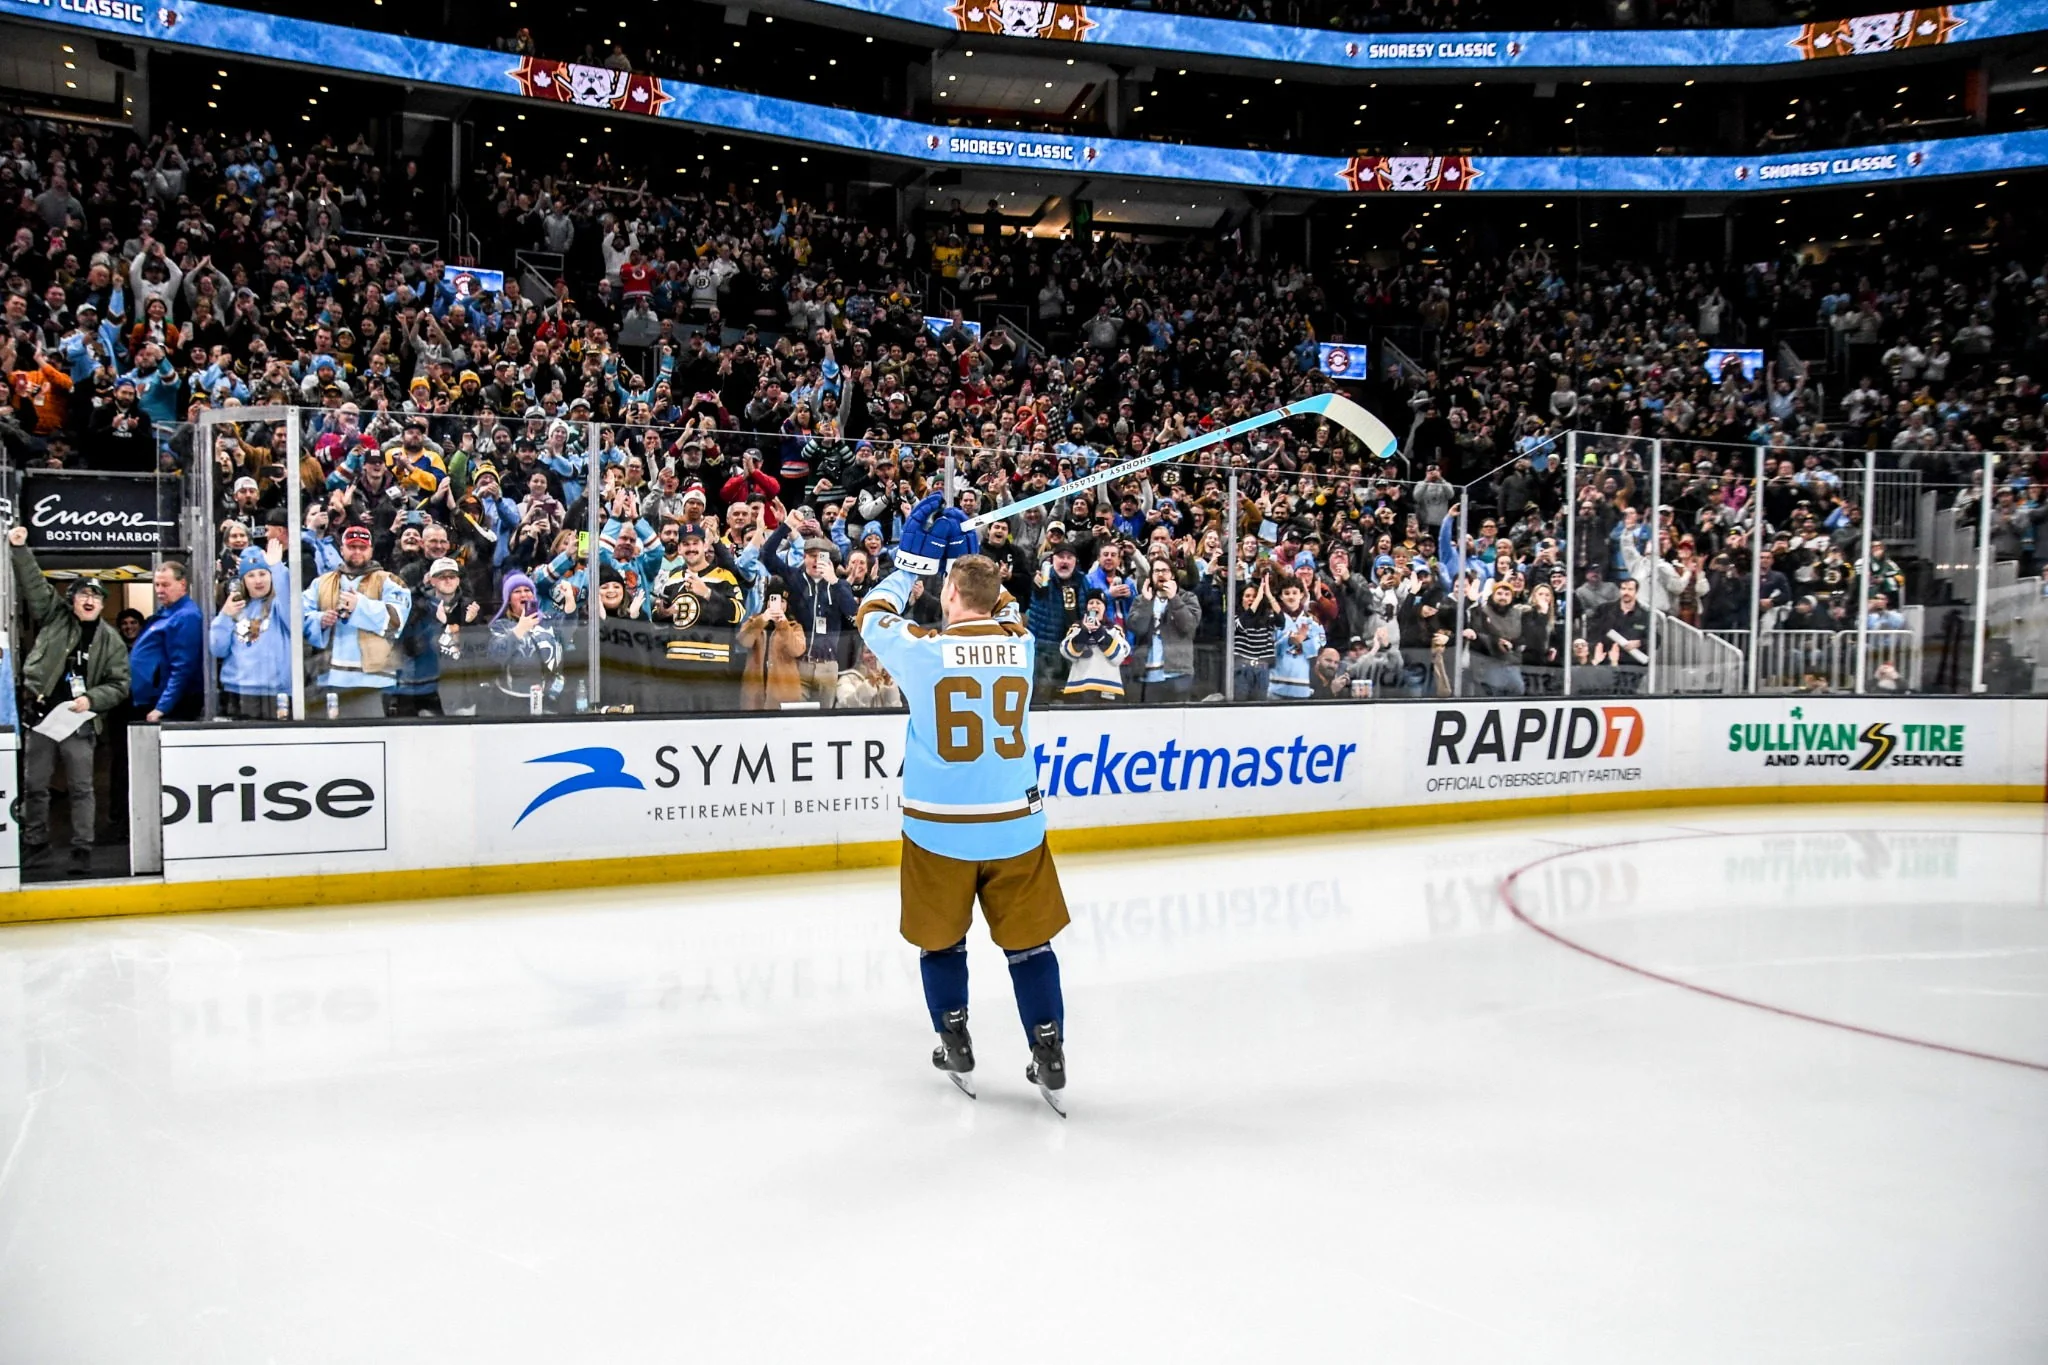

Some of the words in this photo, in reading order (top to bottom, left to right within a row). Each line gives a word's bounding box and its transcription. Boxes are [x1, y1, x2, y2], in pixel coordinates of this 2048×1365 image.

[60, 0, 144, 23] CLASSIC
[1369, 43, 1434, 58] SHORESY
[1438, 43, 1497, 57] CLASSIC
[950, 138, 1015, 156] SHORESY
[1018, 143, 1074, 160] CLASSIC
[1759, 160, 1830, 180] SHORESY
[1832, 154, 1897, 174] CLASSIC
[1110, 455, 1152, 476] SHORESY
[1061, 475, 1096, 493] CLASSIC
[31, 494, 175, 527] Encore
[46, 530, 102, 541] BOSTON
[106, 532, 161, 542] HARBOR
[955, 645, 1018, 665] SHORE
[934, 676, 1029, 762] 69
[1729, 723, 1857, 752] SULLIVAN
[1903, 725, 1965, 751] TIRE
[655, 740, 905, 788] SYMETR
[1034, 734, 1356, 798] ticketmaster
[1765, 754, 1799, 766] AND
[1804, 754, 1850, 766] AUTO
[1891, 755, 1964, 767] SERVICE
[1426, 776, 1486, 792] OFFICIAL
[1488, 770, 1587, 789] CYBERSECURITY
[1588, 768, 1641, 783] PARTNER
[654, 801, 775, 821] RETIREMENT
[794, 796, 880, 814] BENEFITS
